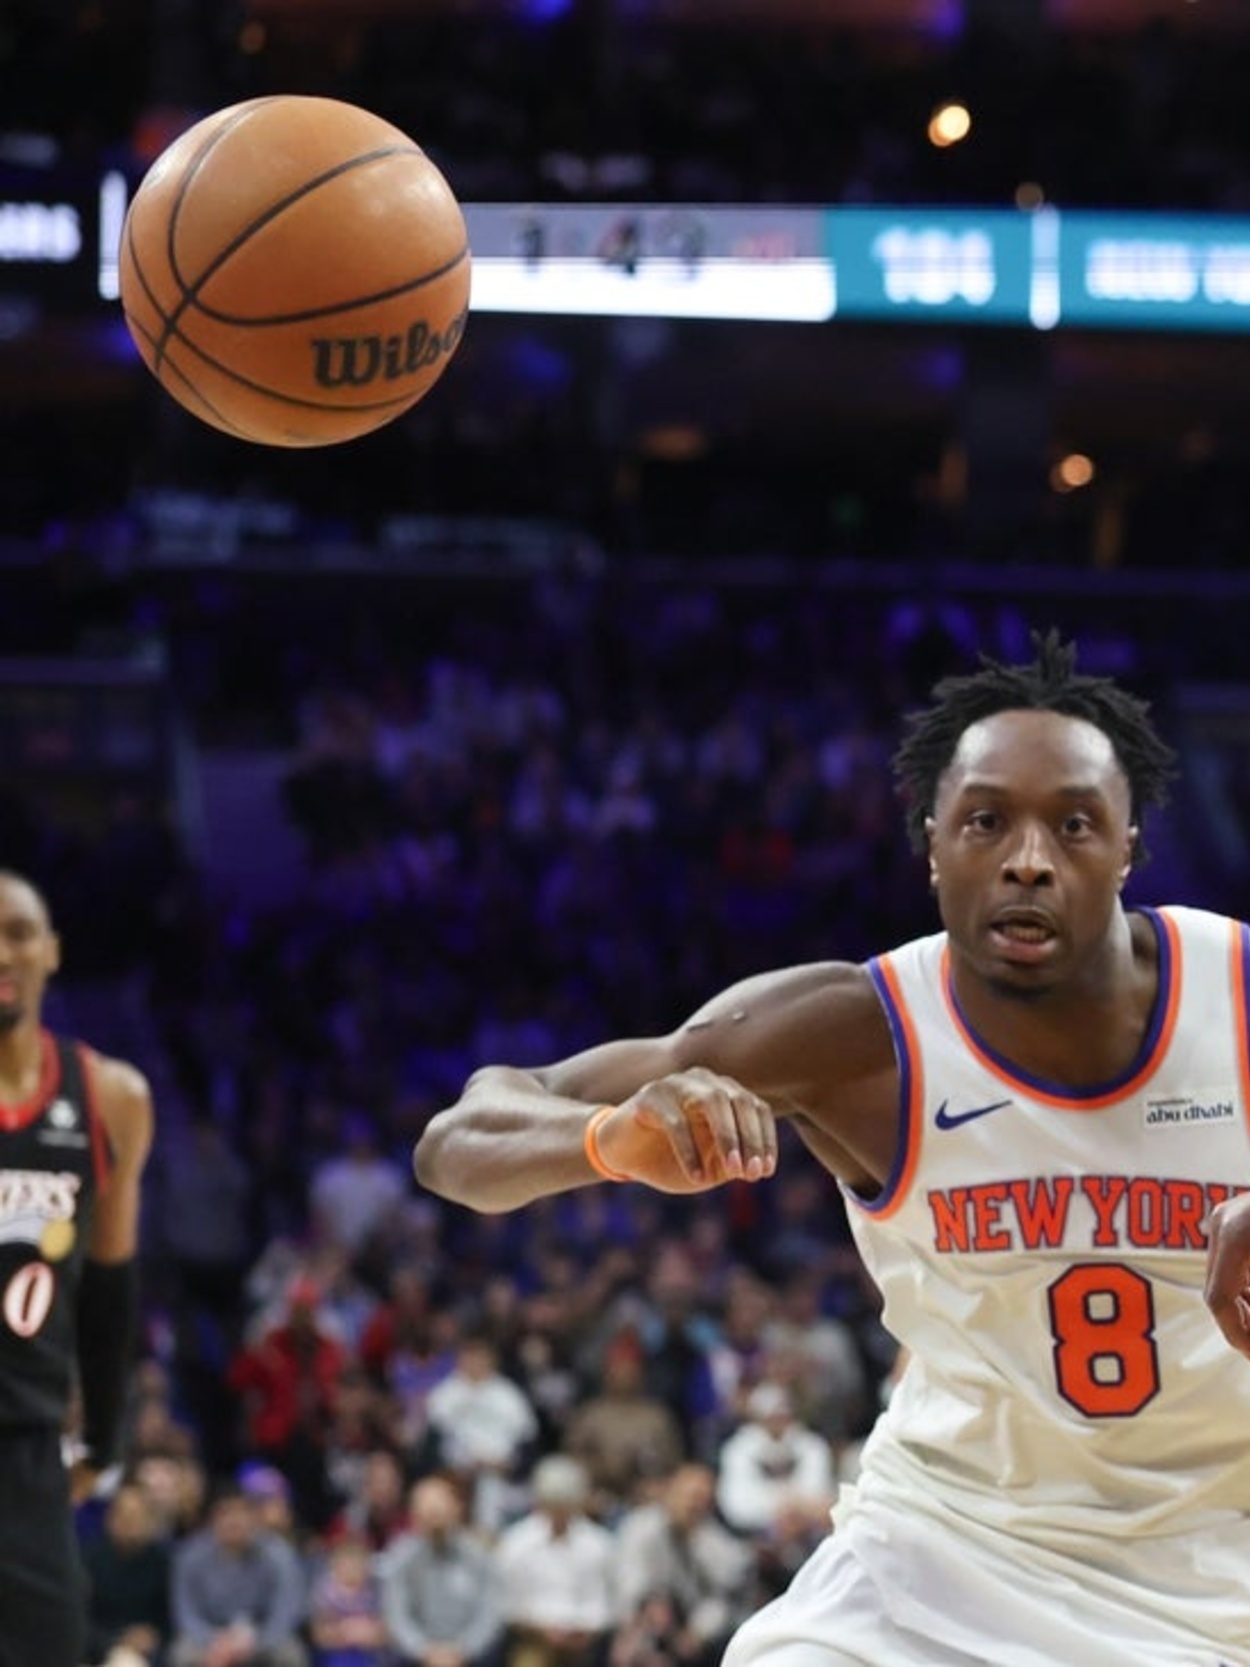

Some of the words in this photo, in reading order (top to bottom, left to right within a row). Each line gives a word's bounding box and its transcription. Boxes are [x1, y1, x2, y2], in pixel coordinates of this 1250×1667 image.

[1146, 1107, 1181, 1124] abu
[1183, 1102, 1235, 1121] dhabi
[928, 1176, 1075, 1253] NEW
[3, 1260, 56, 1339] 0
[1047, 1262, 1161, 1418] 8
